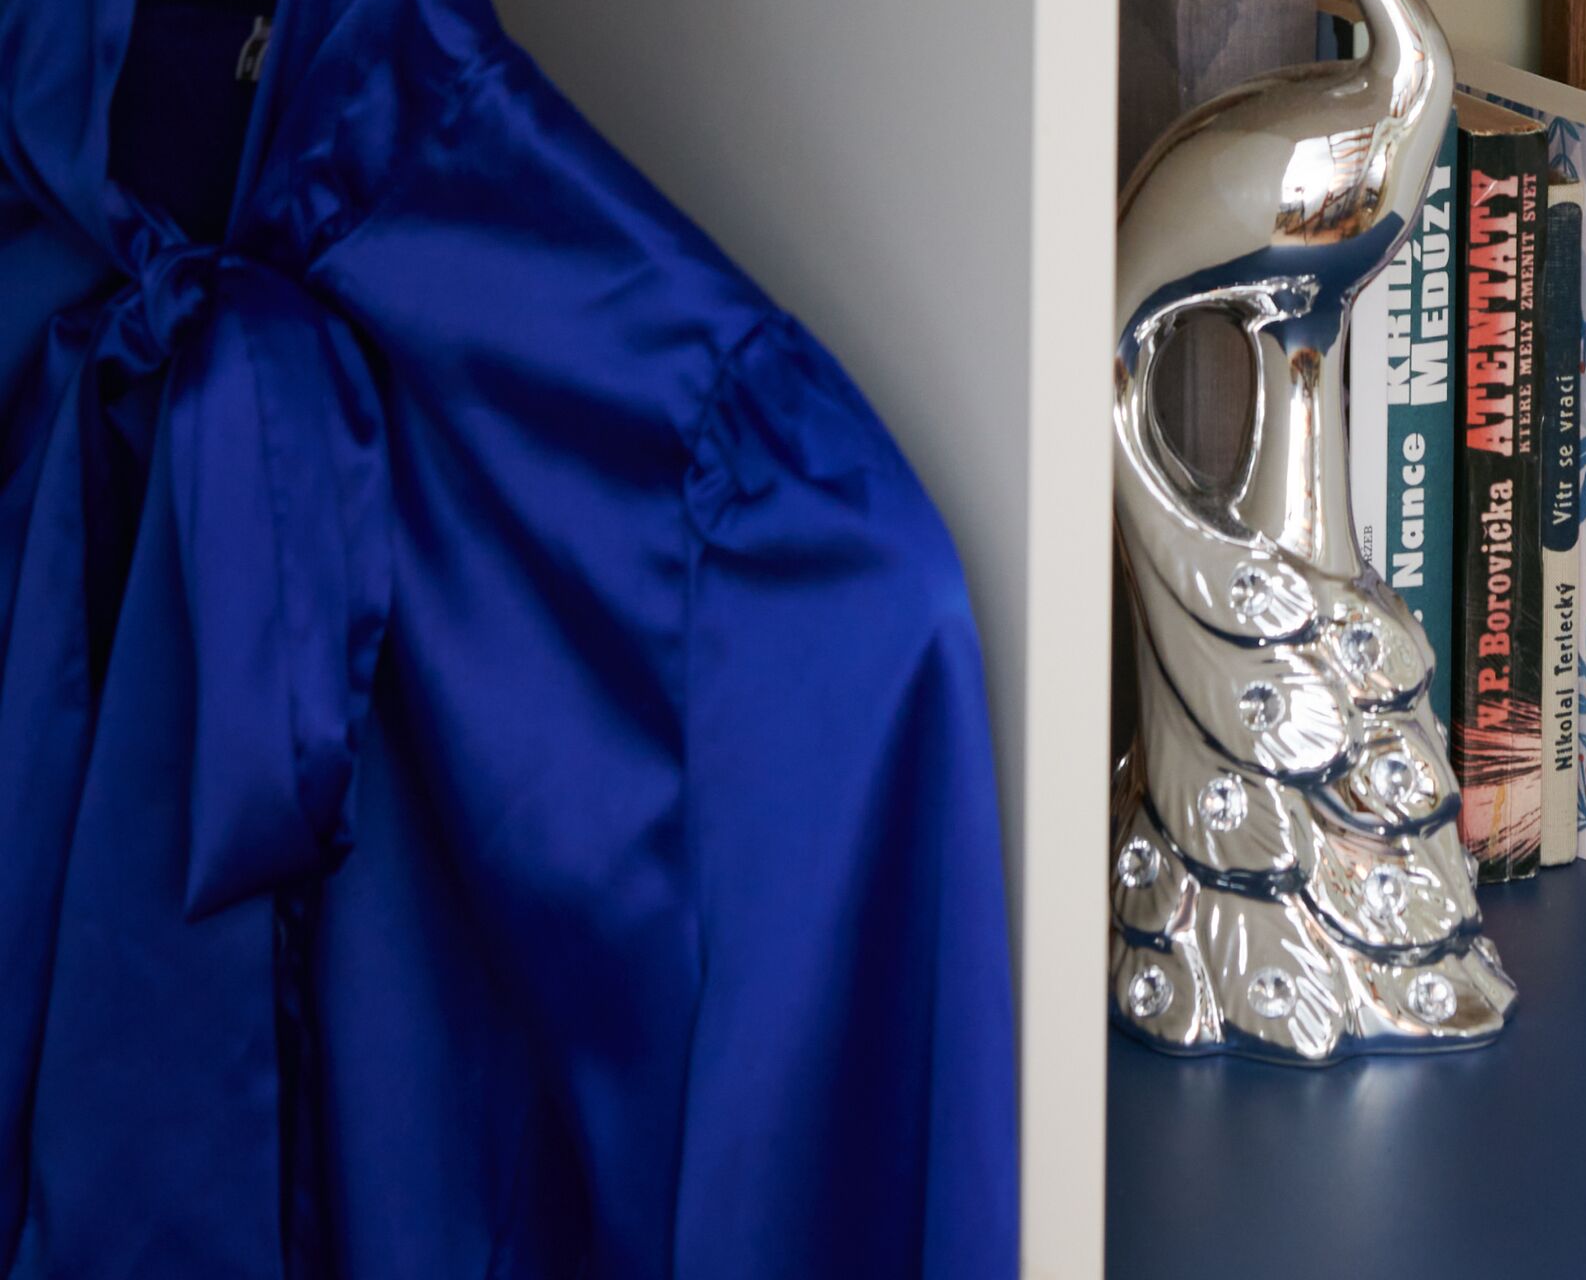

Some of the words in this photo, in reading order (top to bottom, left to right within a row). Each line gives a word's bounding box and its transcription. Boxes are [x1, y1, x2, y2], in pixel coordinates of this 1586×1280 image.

[1410, 165, 1451, 406] MEDÚZY
[1466, 169, 1519, 457] ATENTATY
[1392, 432, 1426, 588] Nance
[1559, 443, 1574, 469] se
[1479, 478, 1514, 657] Borovička
[1553, 582, 1577, 677] Terlecký
[1554, 687, 1575, 773] Nikolaj
